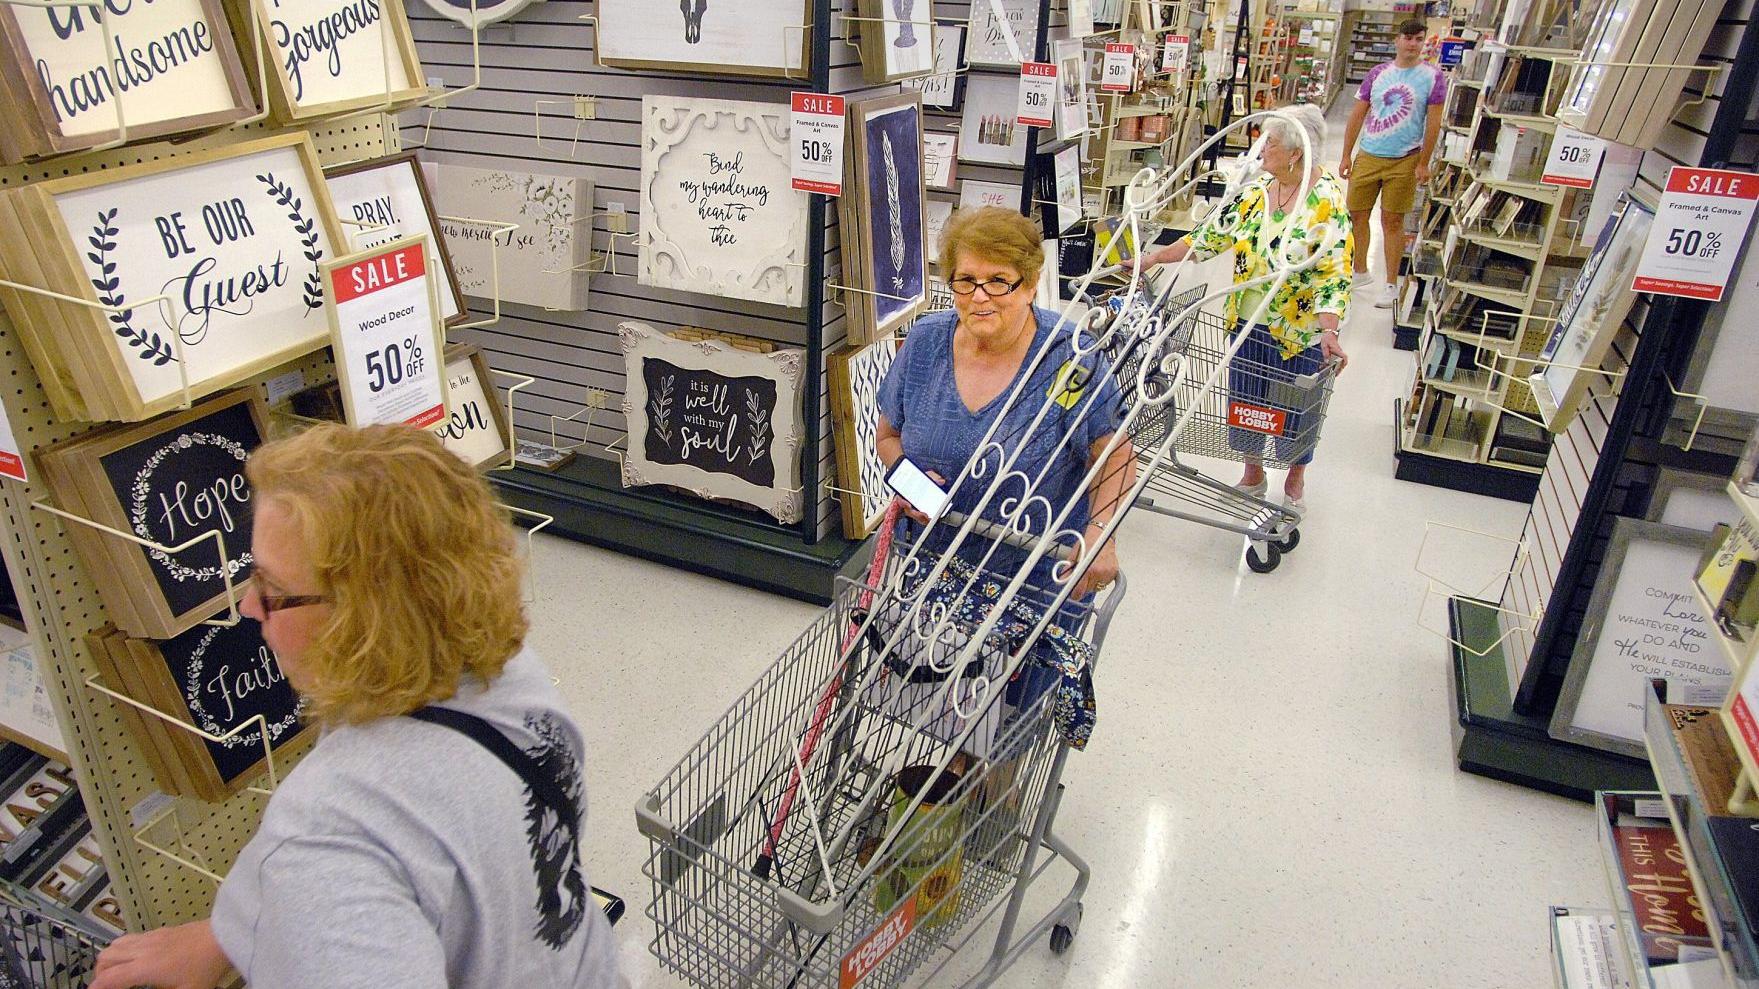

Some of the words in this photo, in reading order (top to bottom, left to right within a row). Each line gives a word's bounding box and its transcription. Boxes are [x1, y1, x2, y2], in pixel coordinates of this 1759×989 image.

[37, 21, 213, 123] handsome
[1029, 66, 1050, 76] SALE
[803, 98, 832, 113] SALE
[796, 120, 814, 128] Framed
[703, 151, 743, 174] Bind
[821, 155, 832, 163] OFF
[680, 181, 700, 203] my
[703, 174, 769, 206] wandering
[1687, 175, 1741, 195] SALE
[699, 197, 745, 221] heart
[735, 207, 754, 221] to
[981, 192, 1005, 205] SHE
[1669, 202, 1701, 212] Framed
[1711, 206, 1742, 215] Canvas
[155, 212, 195, 259] BE
[202, 198, 256, 246] OUR
[709, 224, 736, 247] thee
[517, 235, 536, 250] see
[1700, 248, 1720, 259] OFF
[352, 253, 408, 293] SALE
[163, 250, 288, 342] Guest
[358, 314, 386, 332] Wood
[390, 306, 415, 321] Decor
[406, 358, 424, 378] OFF
[459, 375, 471, 386] the
[691, 380, 698, 391] it
[700, 382, 709, 392] is
[686, 384, 730, 416] well
[684, 414, 706, 426] with
[709, 420, 725, 432] my
[1234, 406, 1276, 421] HOBBY
[1239, 416, 1278, 431] LOBBY
[681, 413, 741, 462] soul
[159, 473, 250, 541] Hope
[1618, 615, 1680, 632] WHATEVER
[1683, 626, 1707, 645] you
[1614, 638, 1639, 658] He
[1642, 653, 1668, 665] WILL
[1643, 634, 1664, 646] DO
[1669, 641, 1700, 653] AND
[1631, 663, 1661, 675] YOUR
[1628, 834, 1656, 865] THIS
[848, 910, 905, 973] HOBBY
[856, 919, 908, 979] LOBBY
